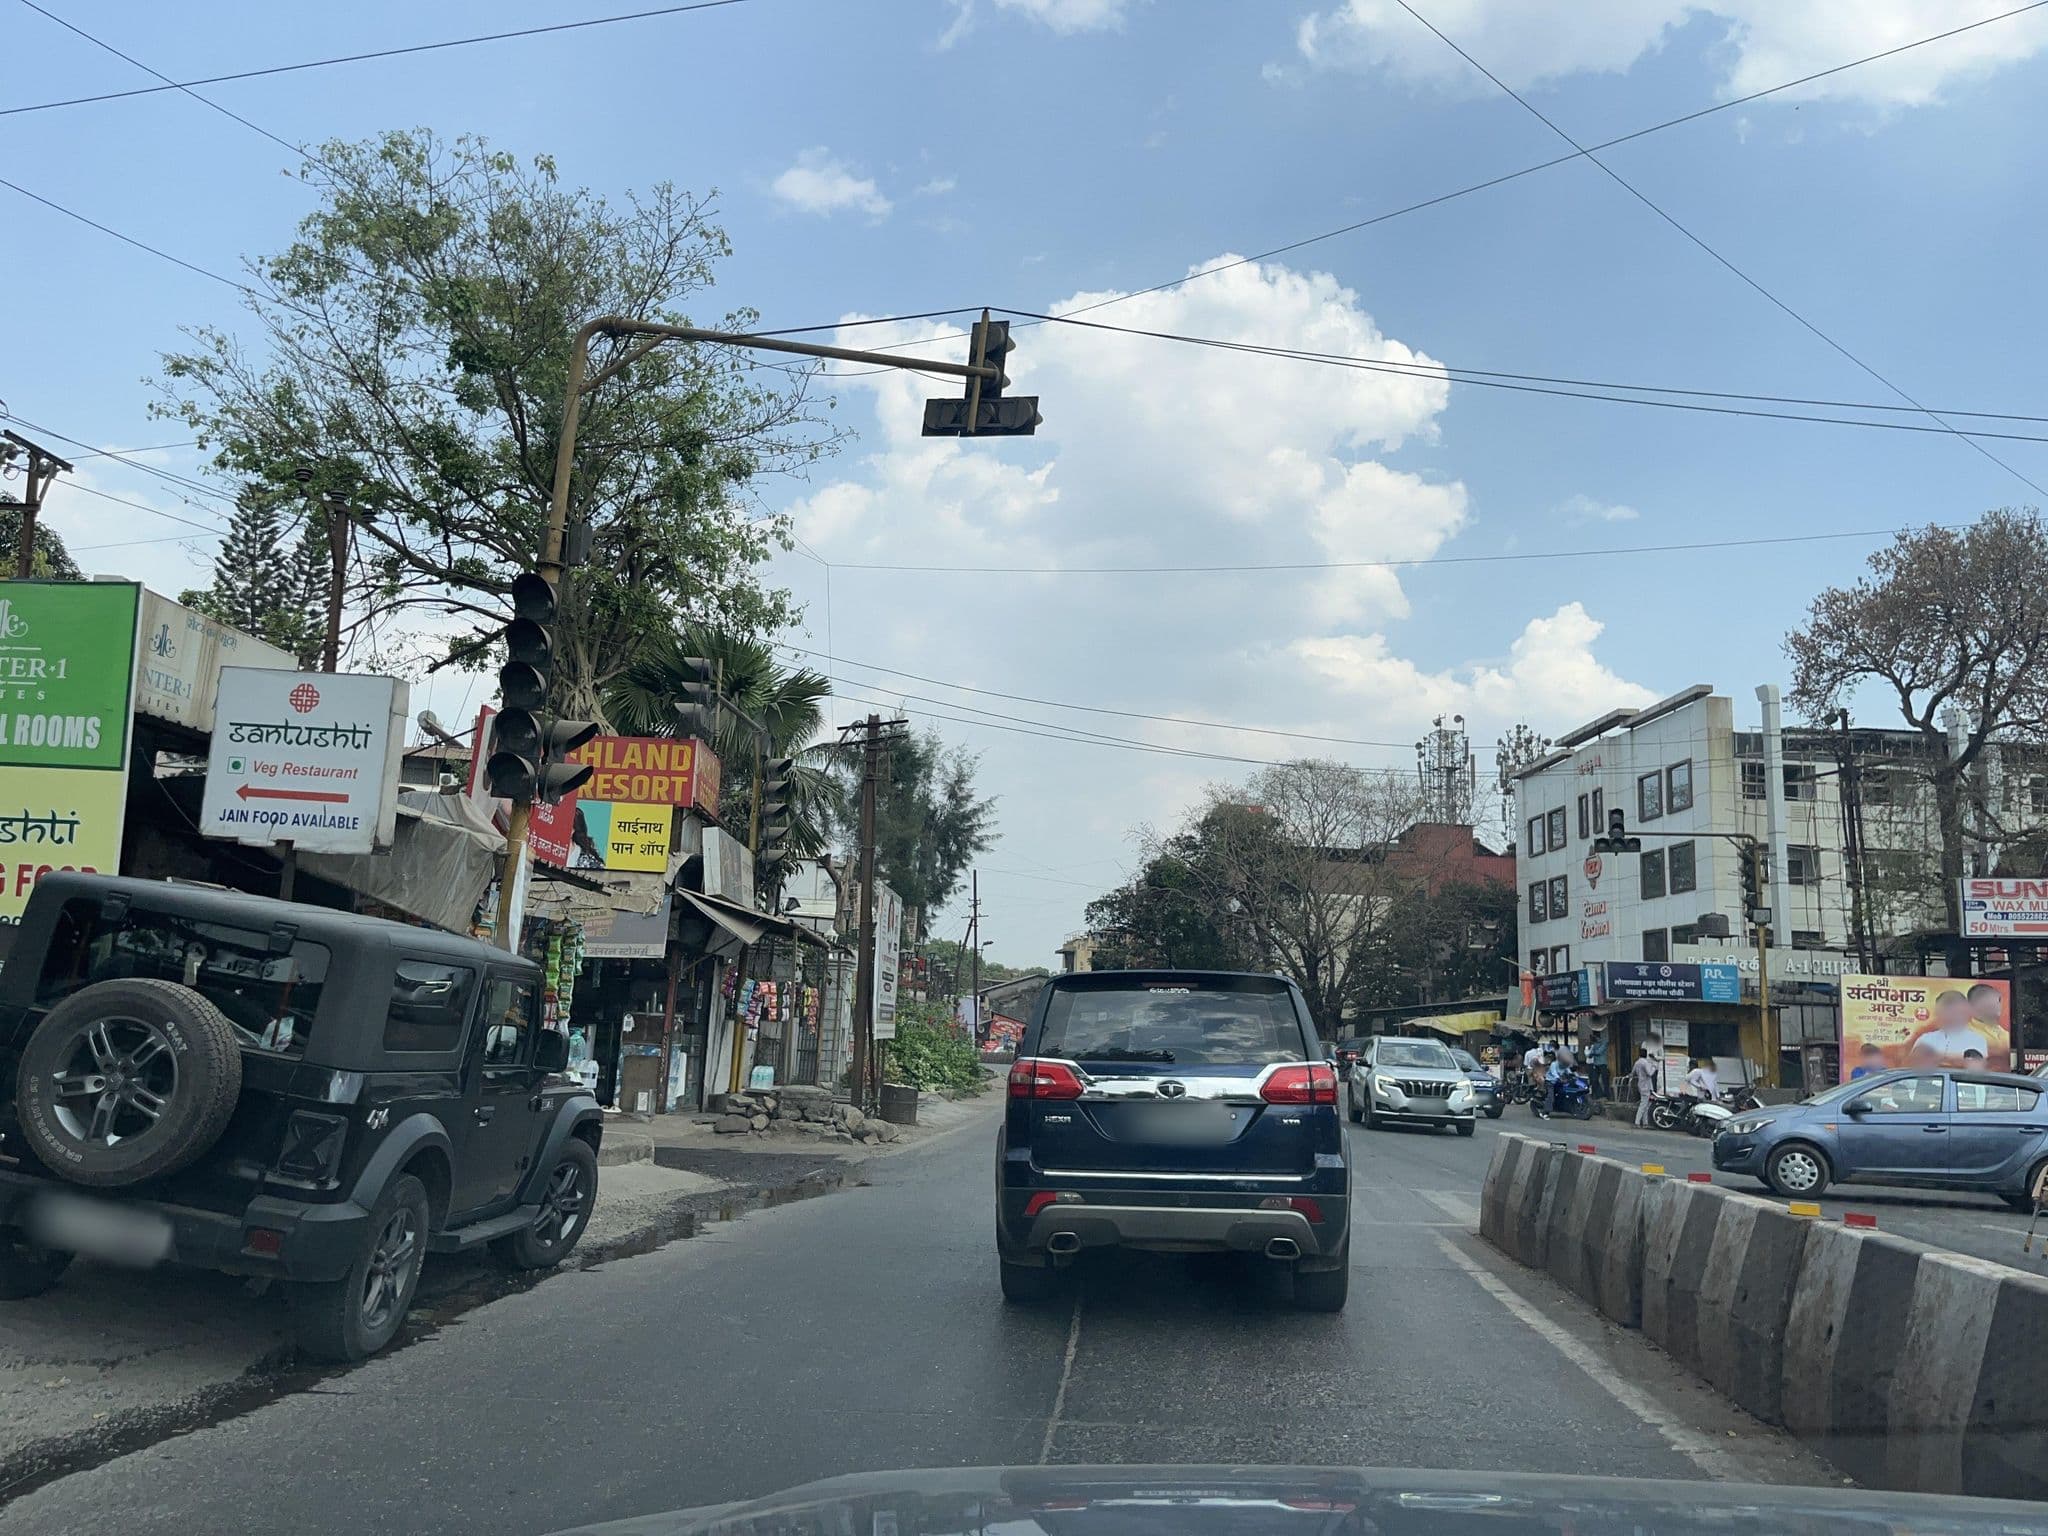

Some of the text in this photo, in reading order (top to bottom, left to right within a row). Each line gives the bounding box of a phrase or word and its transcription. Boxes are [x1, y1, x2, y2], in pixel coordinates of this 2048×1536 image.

[14, 714, 101, 749] ROOMS
[229, 718, 373, 750] santushti
[253, 760, 359, 779] Veg Restaurant
[577, 773, 689, 802] RESORT
[219, 808, 360, 830] JAIN FOOD AVAILABLE
[617, 817, 664, 835] साईनाथ
[611, 840, 665, 856] पान शॉप
[1992, 901, 2025, 911] WAX
[1986, 912, 2002, 920] Mob
[1970, 922, 1988, 933] 50
[1785, 957, 1808, 974] A-1
[1876, 977, 1889, 987] श्री
[1846, 983, 1926, 1003] संदीपभाऊ
